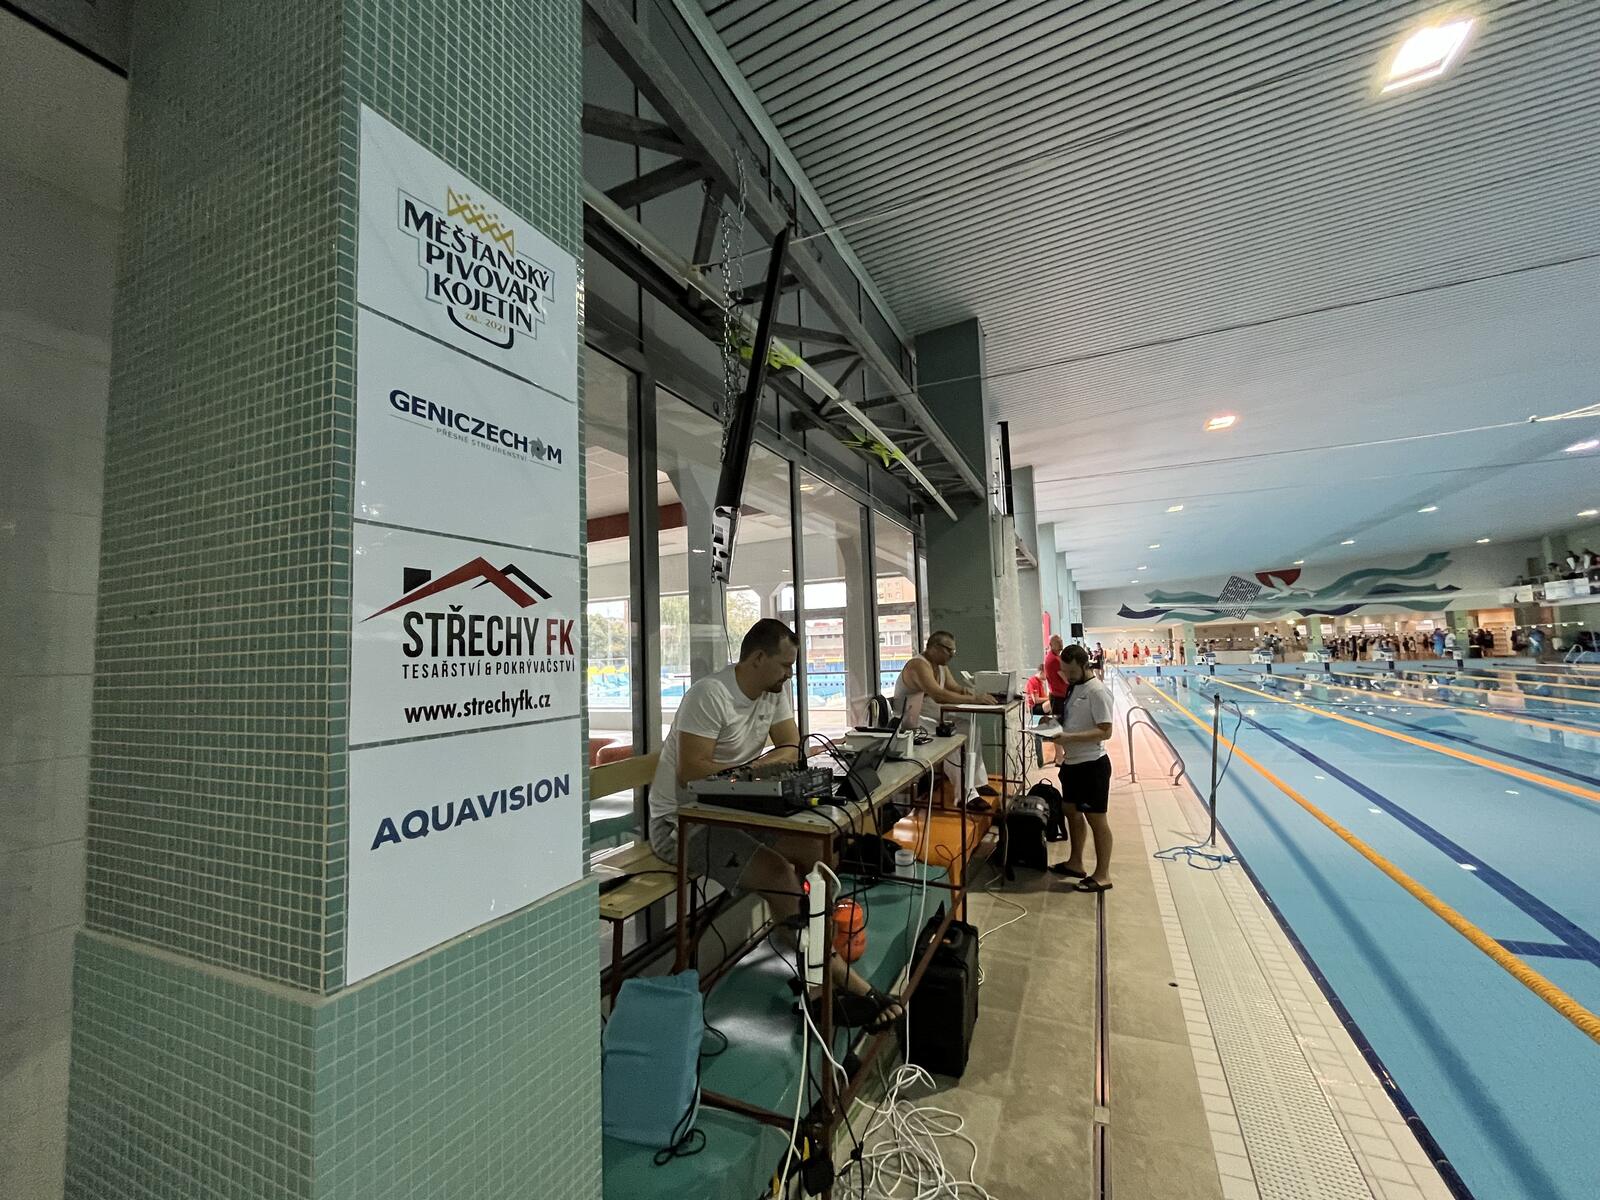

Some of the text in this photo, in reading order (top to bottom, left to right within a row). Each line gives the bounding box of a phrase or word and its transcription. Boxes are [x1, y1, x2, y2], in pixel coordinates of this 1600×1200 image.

[404, 199, 550, 292] MĚŠŤANSKÝ
[426, 241, 541, 314] PIVOVAR
[434, 273, 532, 333] KOJETÍN
[485, 318, 507, 333] 2021
[402, 604, 575, 658] STŘECHY FK
[402, 657, 575, 680] TESAŘSTVÍ & POKRÝVAČSTVÍ
[404, 689, 551, 724] www.strechyfk.cz
[370, 773, 570, 851] AQUAVISION
